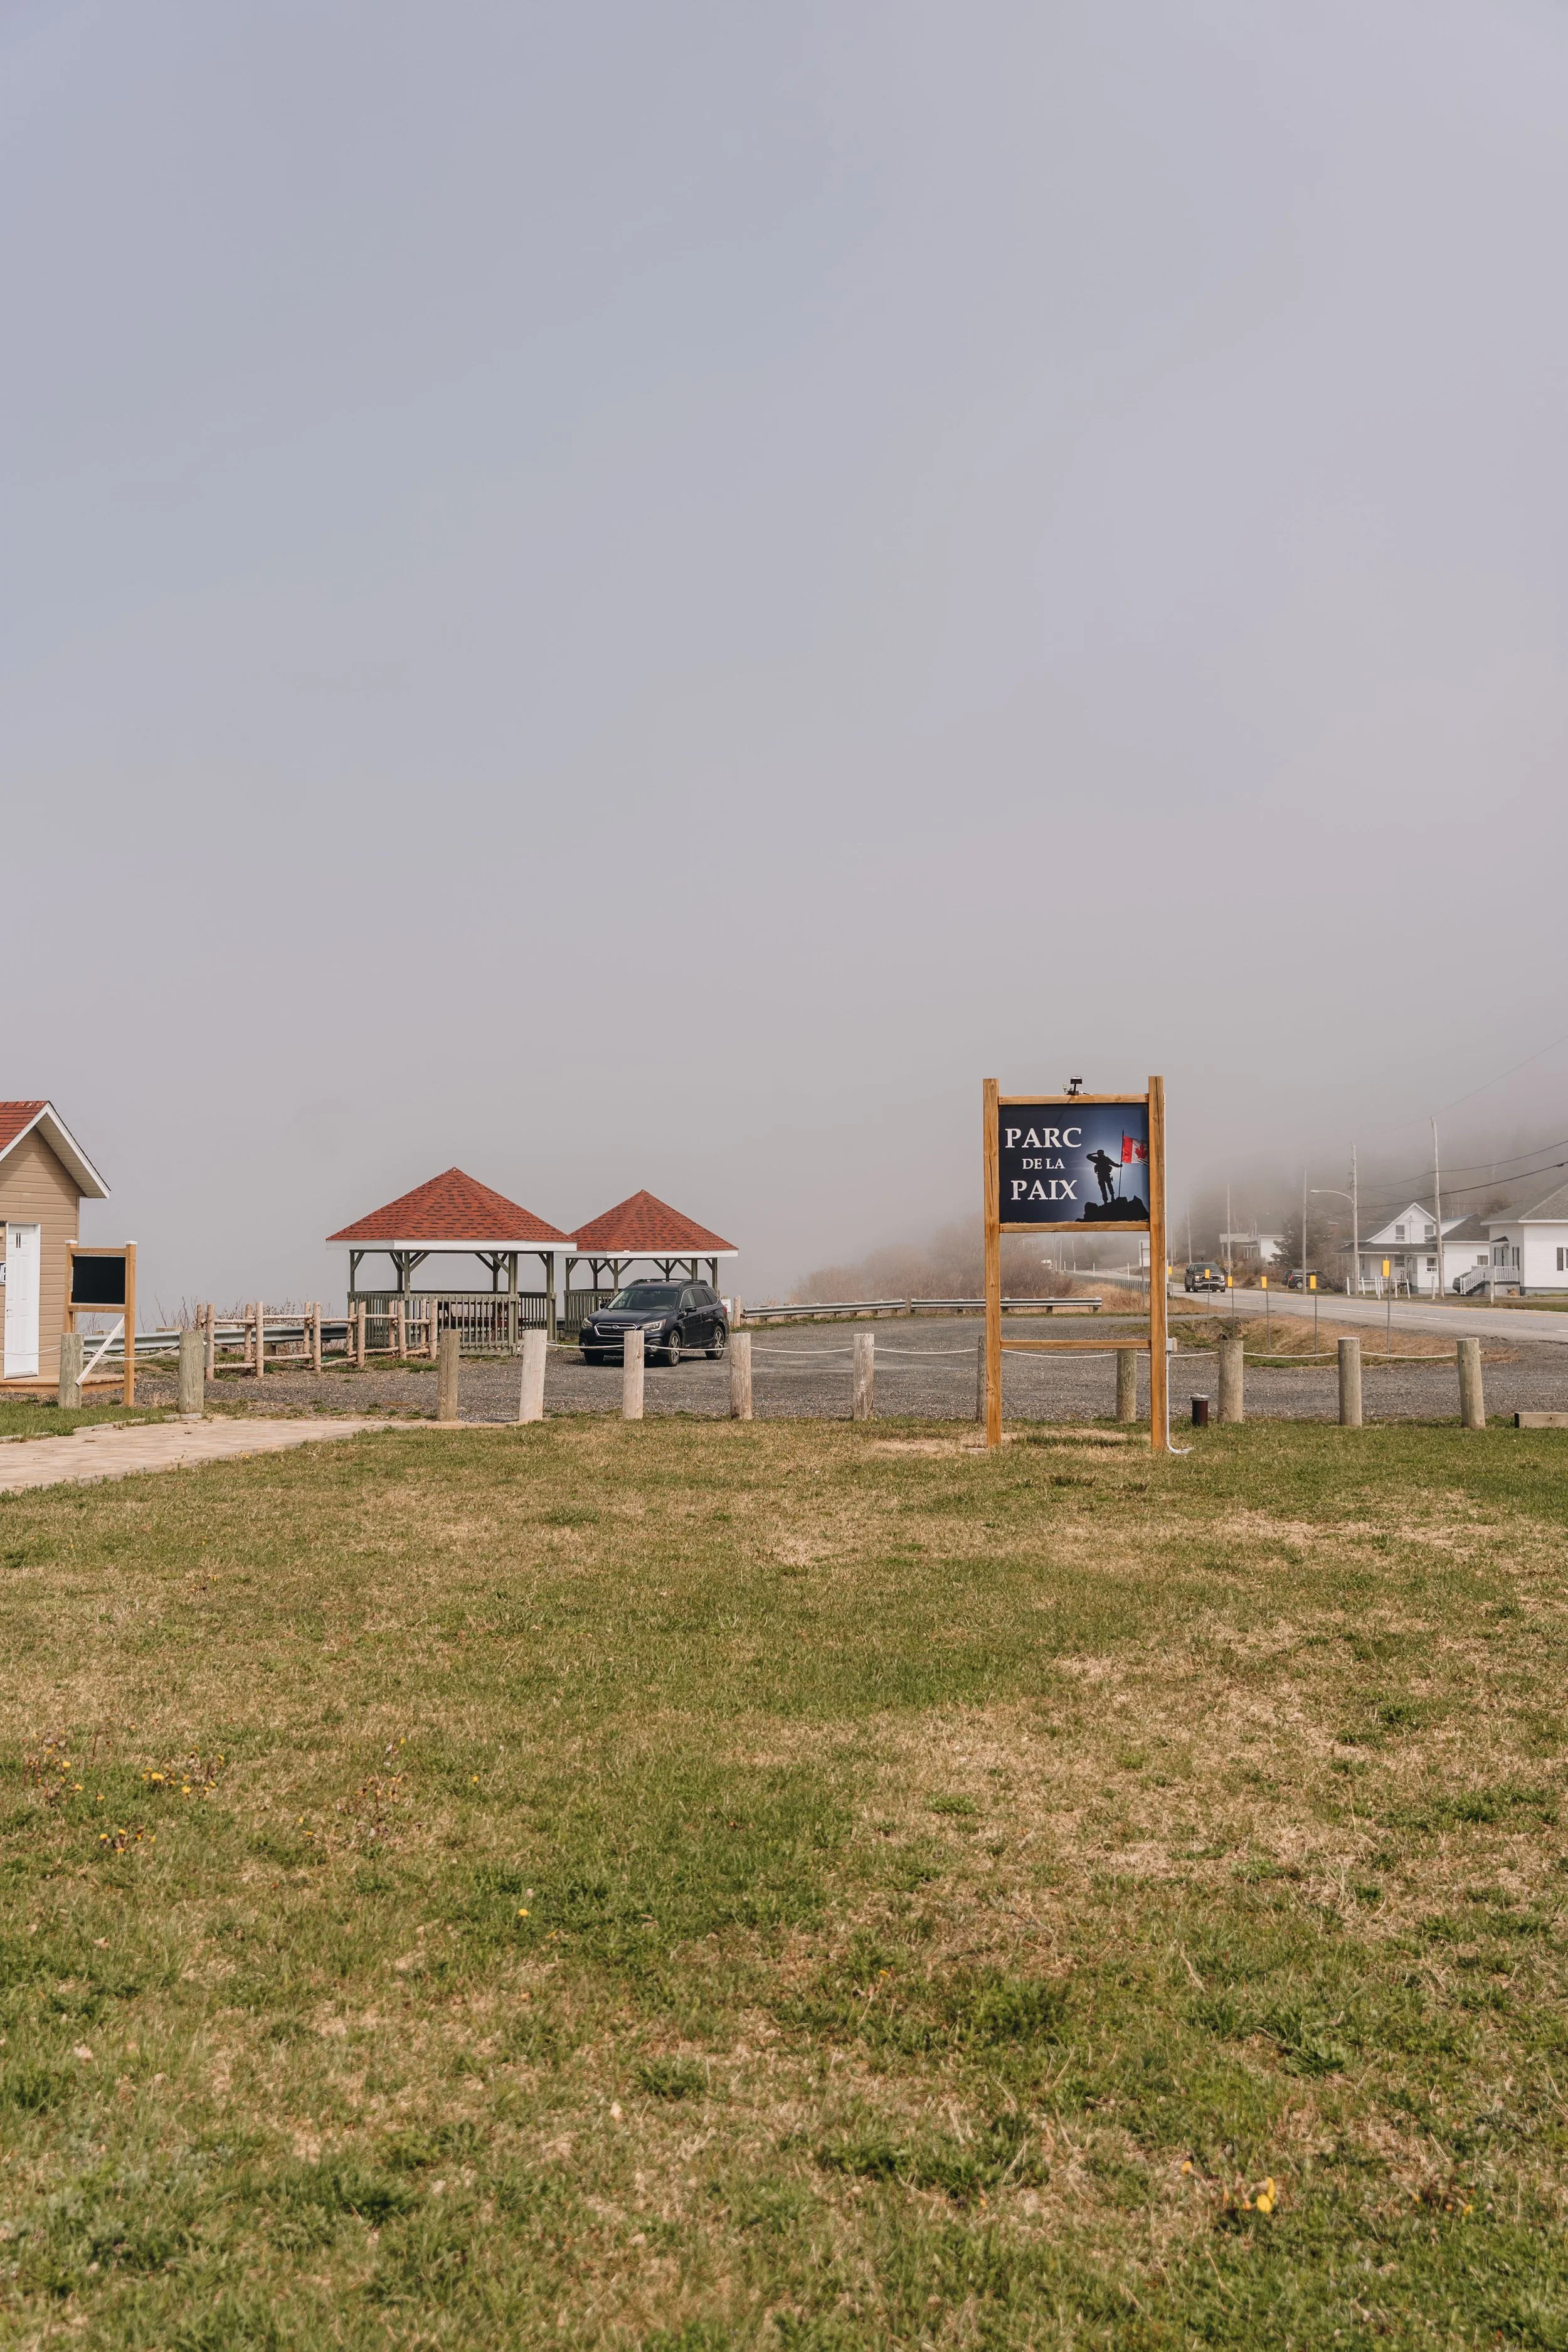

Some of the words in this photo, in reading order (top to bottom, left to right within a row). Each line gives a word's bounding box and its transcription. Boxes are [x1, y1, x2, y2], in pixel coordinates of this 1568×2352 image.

[1005, 1128, 1081, 1148] PARC
[1022, 1158, 1042, 1169] DE
[1046, 1158, 1065, 1169] LA
[1011, 1180, 1078, 1200] PAIX
